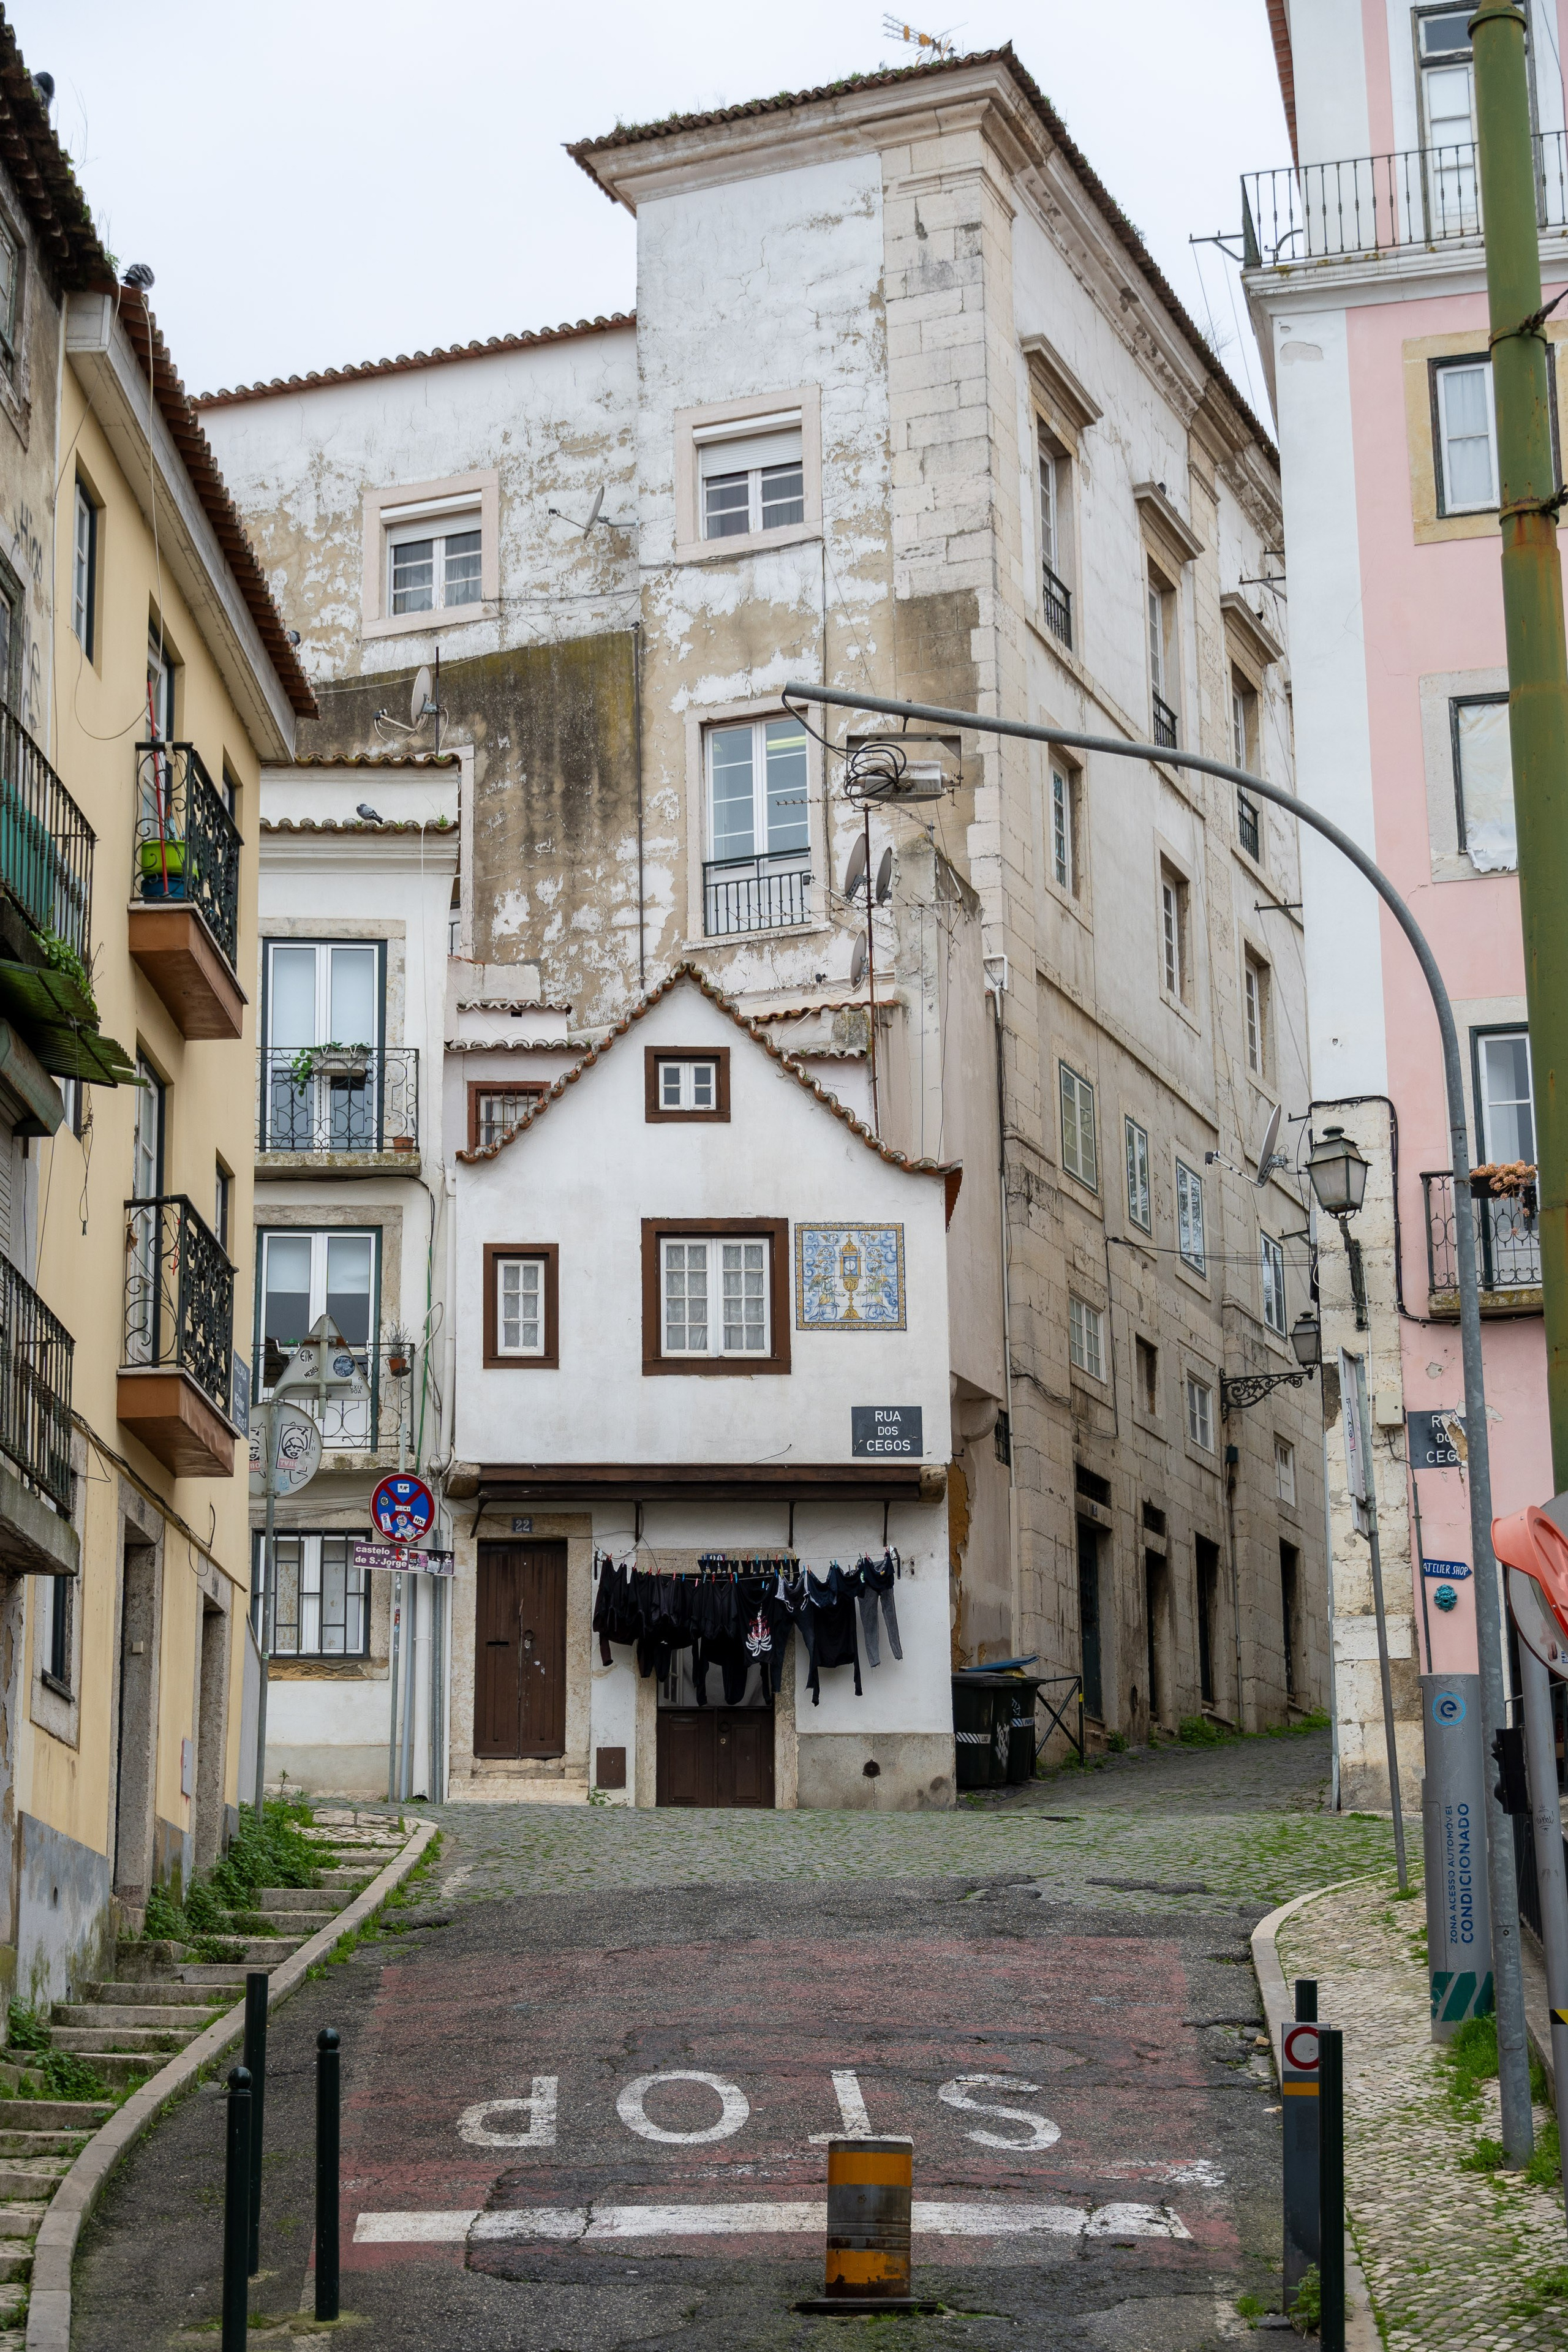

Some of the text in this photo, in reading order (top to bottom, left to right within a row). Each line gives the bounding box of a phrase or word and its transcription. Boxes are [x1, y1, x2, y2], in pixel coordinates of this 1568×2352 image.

[875, 1411, 902, 1422] RUA
[878, 1427, 899, 1436] DOS
[867, 1440, 911, 1452] CEGOS
[515, 1519, 530, 1532] 22
[355, 1546, 390, 1555] castelo
[1423, 1562, 1469, 1576] ATELIER SHOP
[1445, 1805, 1455, 1868] AUTOMÓVEL
[1457, 1803, 1474, 1944] CONDICIONADO
[1448, 1870, 1457, 1912] ACESSO
[457, 2068, 1061, 2152] STOP
